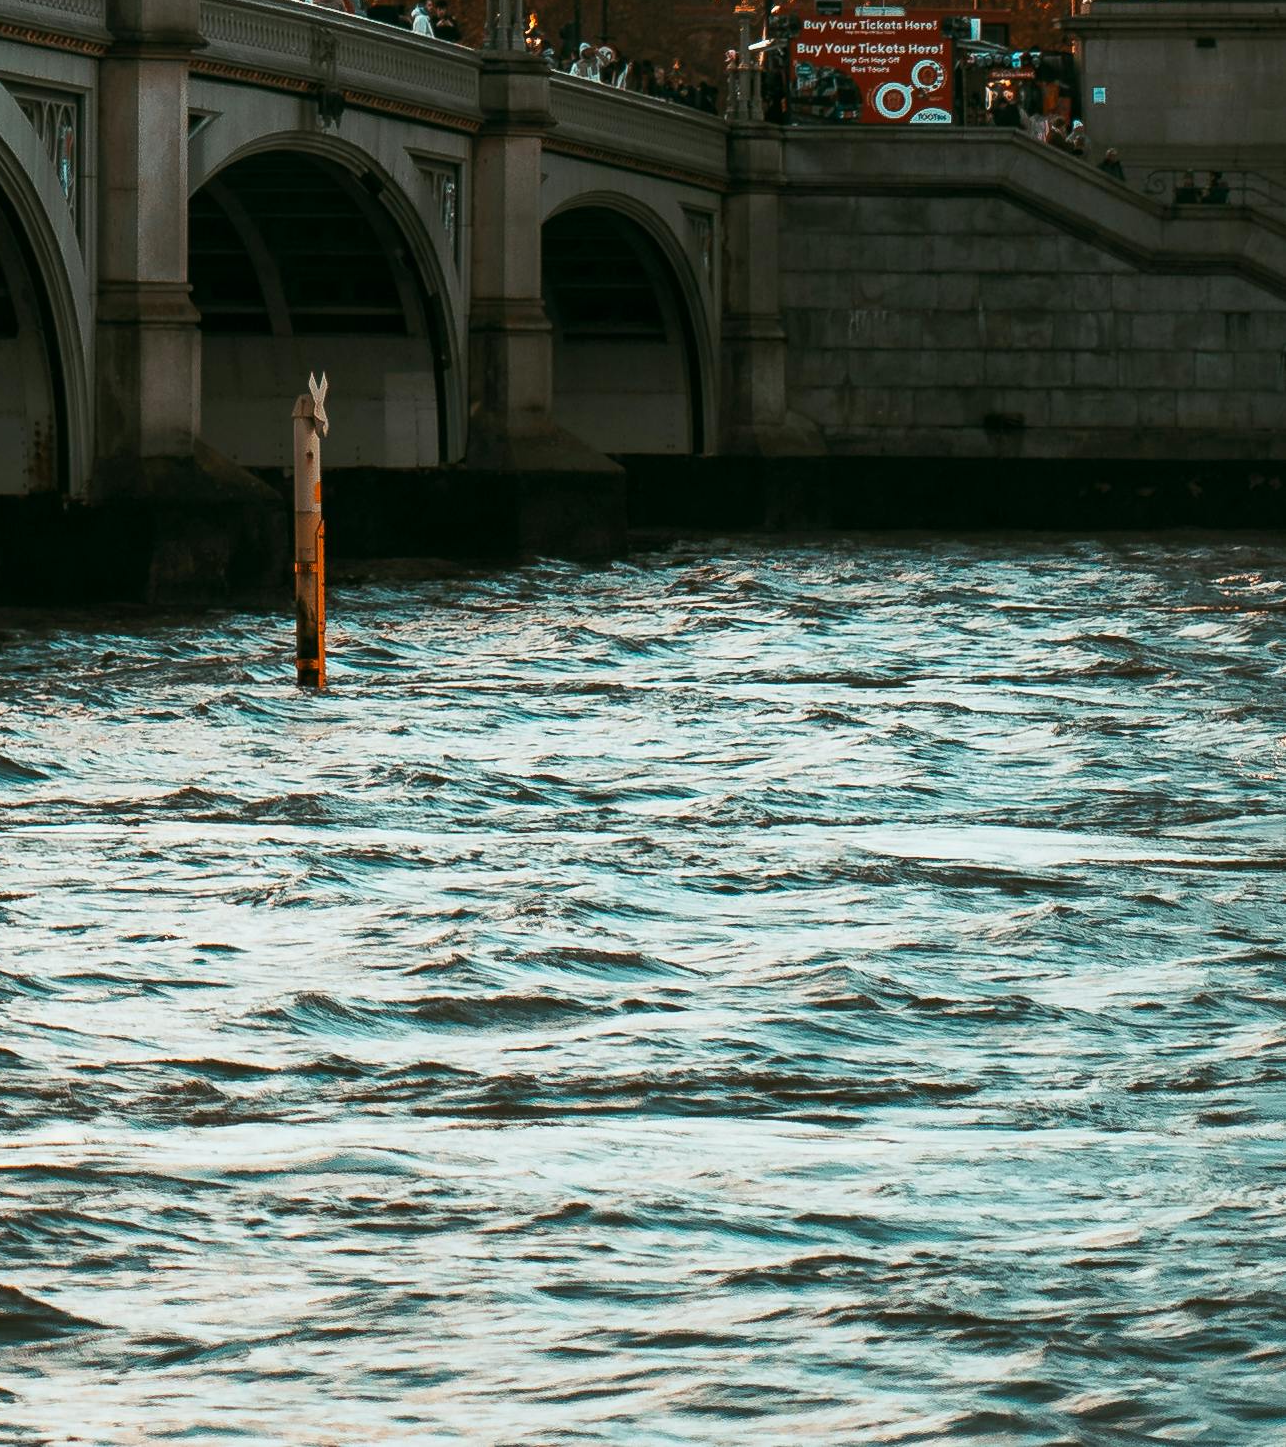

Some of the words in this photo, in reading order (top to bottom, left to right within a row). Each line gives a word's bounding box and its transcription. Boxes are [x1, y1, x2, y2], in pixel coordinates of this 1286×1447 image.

[803, 20, 827, 33] Buy
[829, 20, 857, 30] Your
[857, 19, 902, 30] Tickets
[905, 20, 938, 31] Here!
[797, 43, 822, 57] Buy
[825, 43, 856, 54] Your
[858, 42, 905, 54] Tickets
[908, 43, 944, 54] Here!
